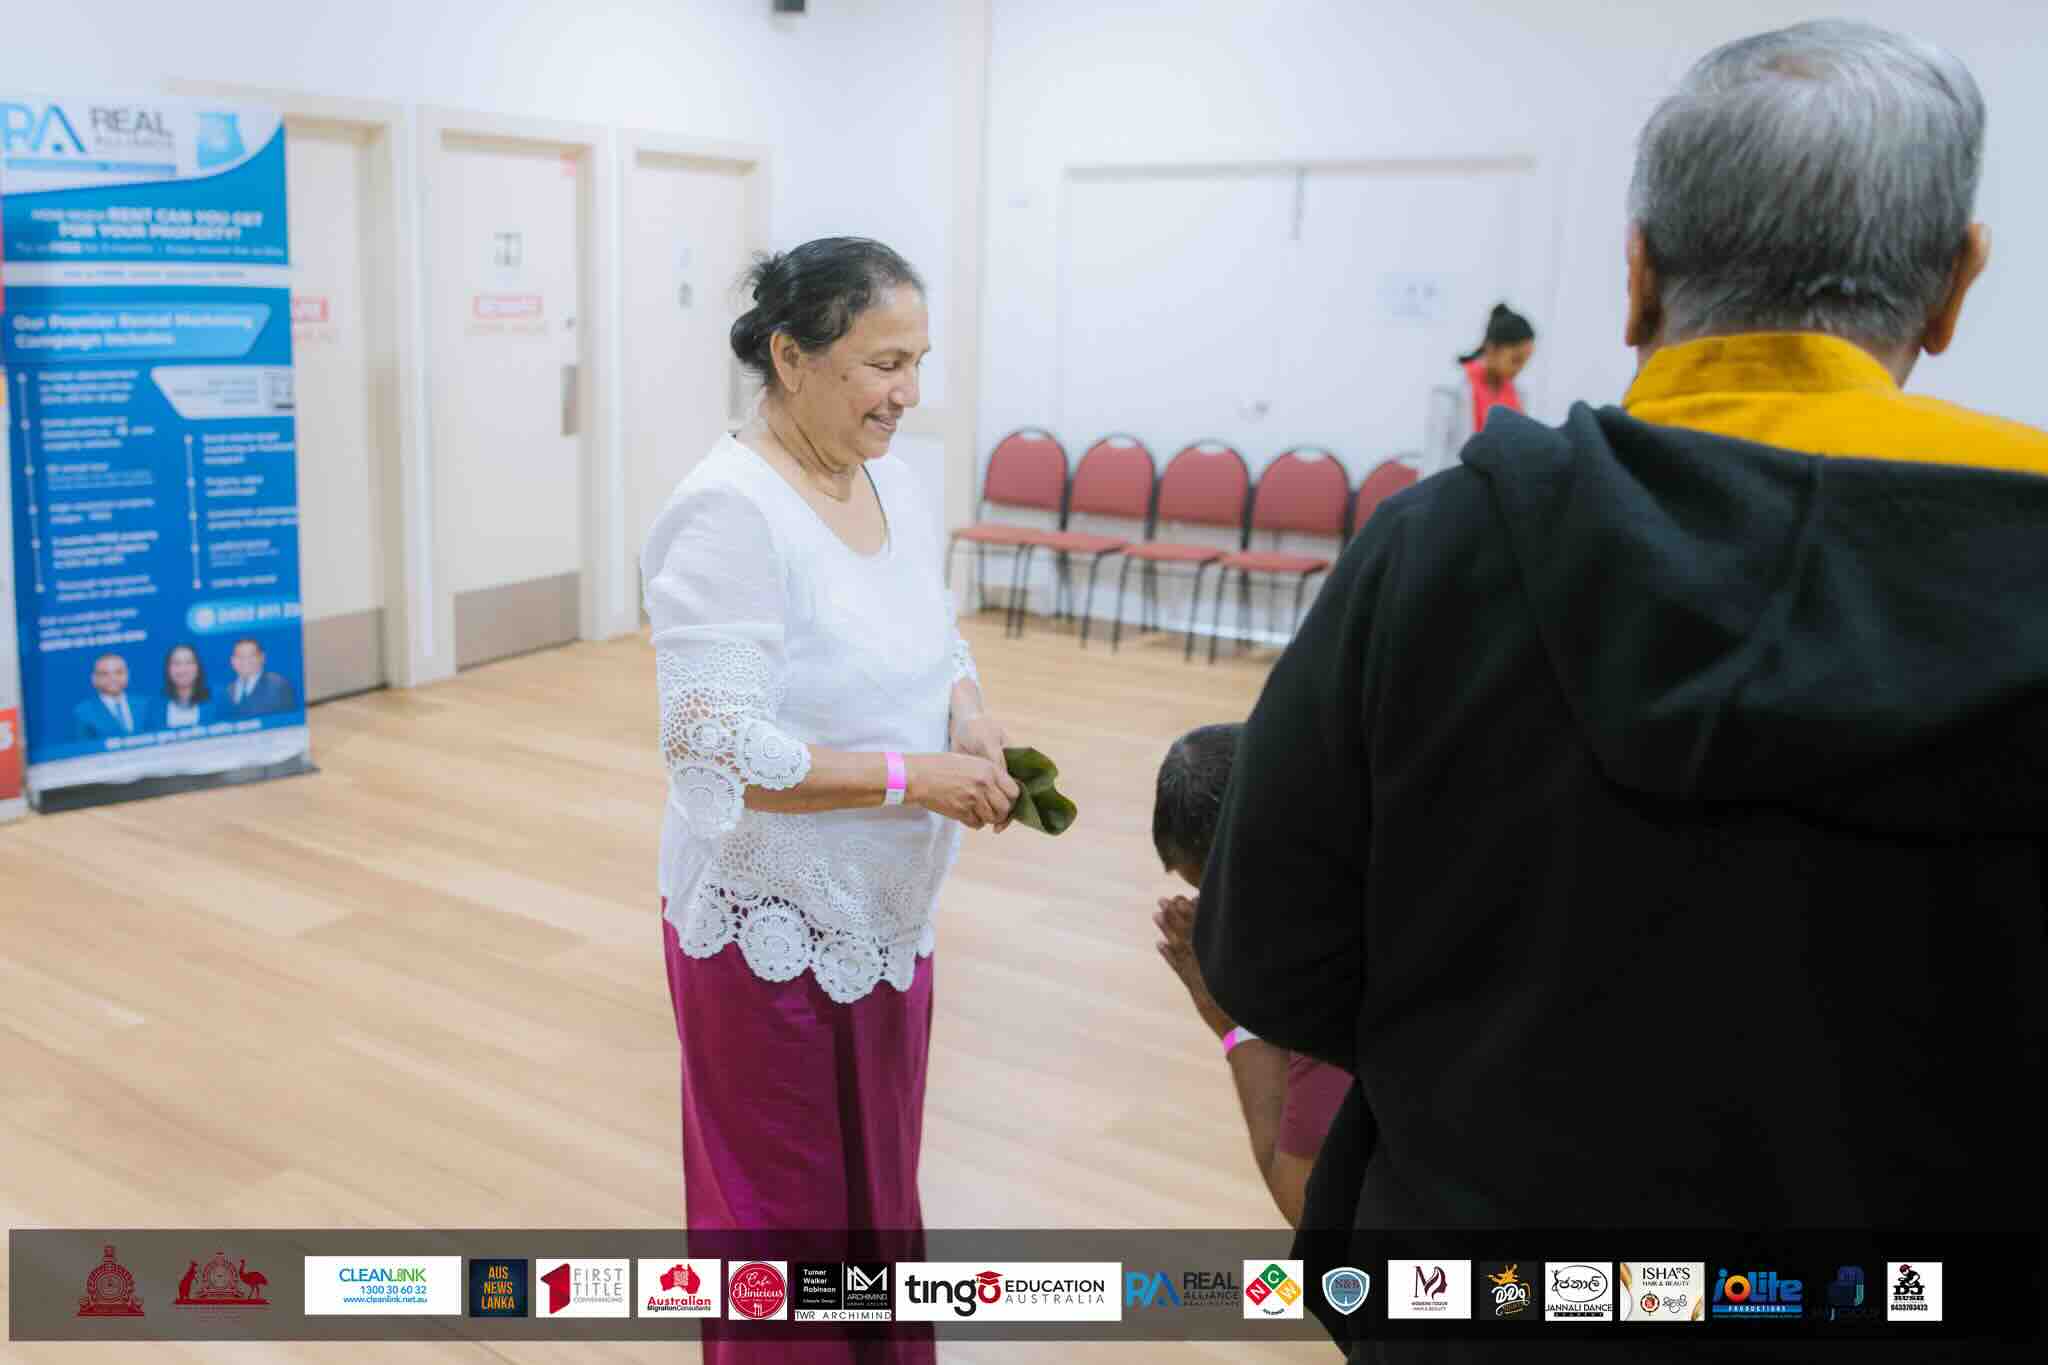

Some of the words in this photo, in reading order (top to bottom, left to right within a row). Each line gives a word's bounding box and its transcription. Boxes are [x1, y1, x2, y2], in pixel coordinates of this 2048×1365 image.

[90, 105, 172, 136] REAL
[107, 206, 153, 224] RENT
[156, 207, 193, 225] CAN
[195, 209, 231, 226] YOU
[58, 222, 96, 240] FOR
[99, 222, 146, 240] YOUR
[12, 314, 46, 330] Our
